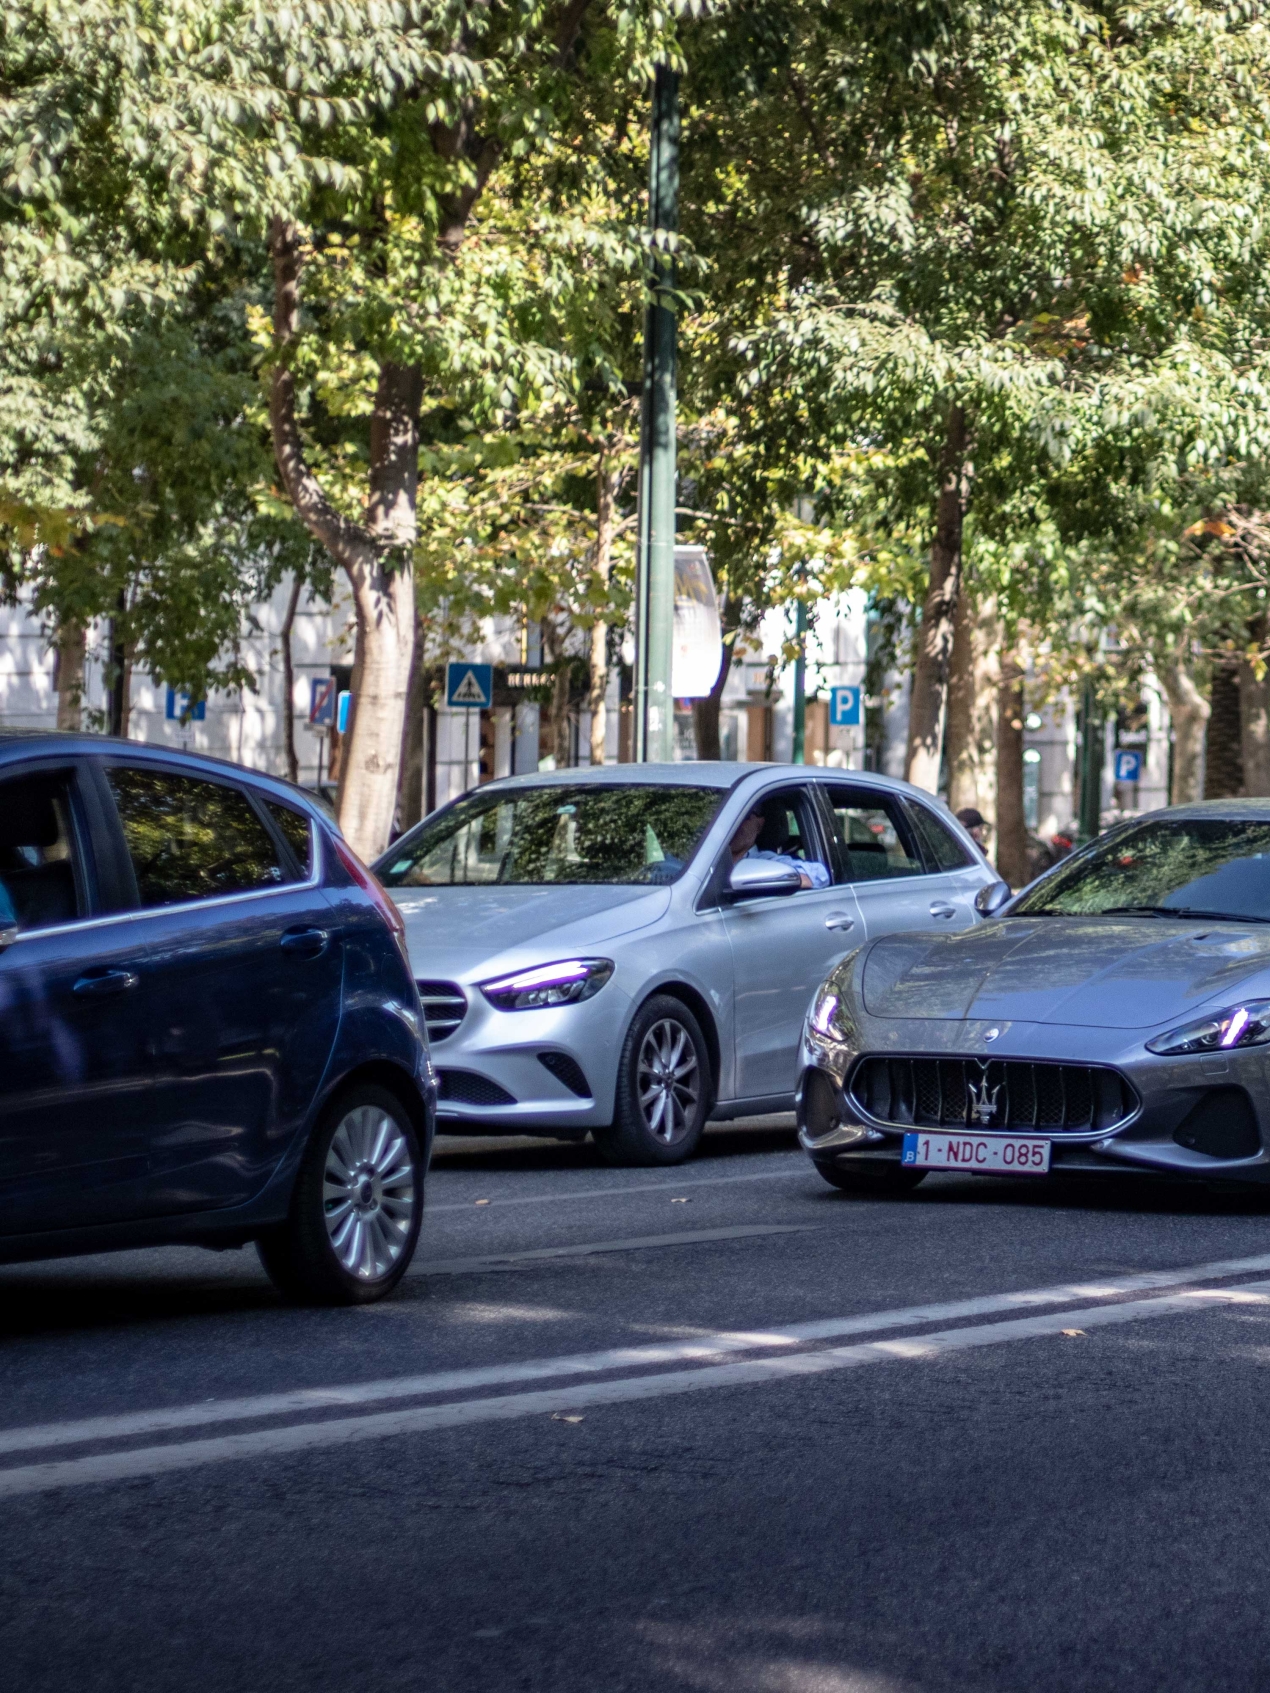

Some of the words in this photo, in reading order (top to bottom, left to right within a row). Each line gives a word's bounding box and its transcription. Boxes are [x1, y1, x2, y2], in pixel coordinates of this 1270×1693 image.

[836, 689, 854, 721] P
[1120, 754, 1137, 777] P
[906, 1151, 915, 1161] B
[922, 1139, 1045, 1167] 1-NDC-085
